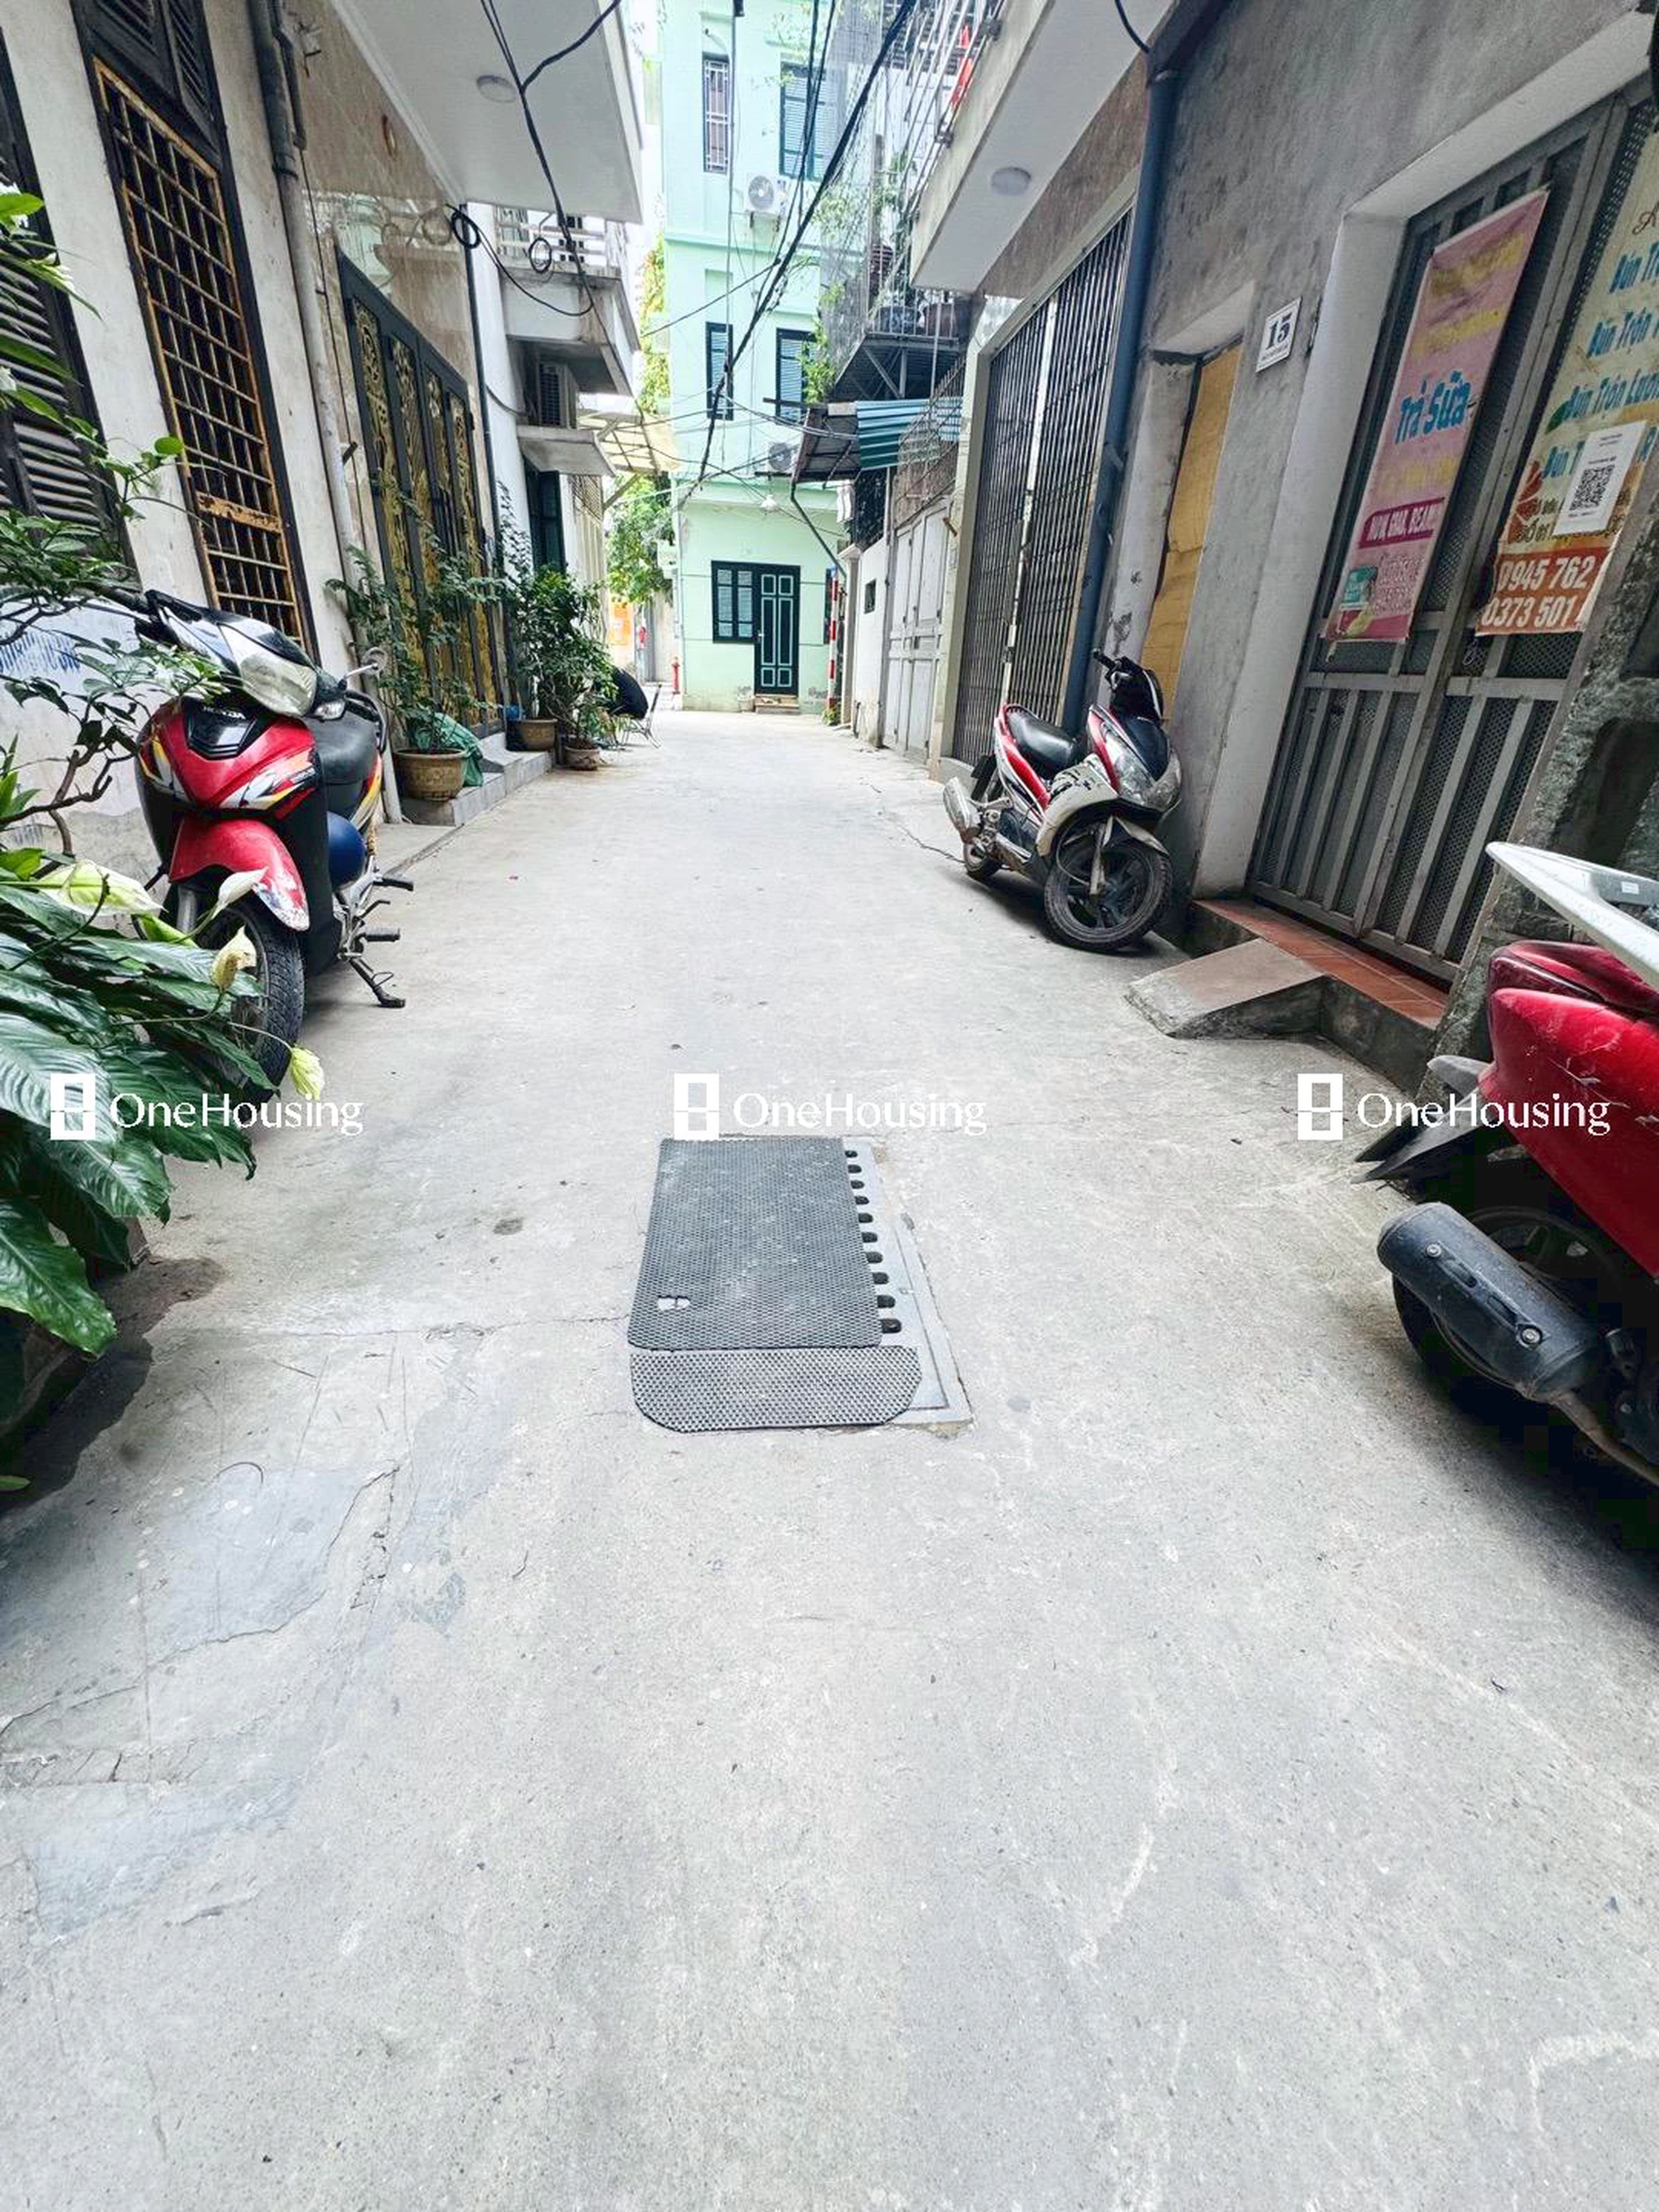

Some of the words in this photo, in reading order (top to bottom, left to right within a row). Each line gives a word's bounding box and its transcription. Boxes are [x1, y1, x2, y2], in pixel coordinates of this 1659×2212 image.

[1265, 312, 1293, 351] 15
[1497, 558, 1551, 591] 0945
[1548, 555, 1597, 589] 762
[1481, 597, 1536, 627] 0373
[1534, 595, 1580, 627] 501
